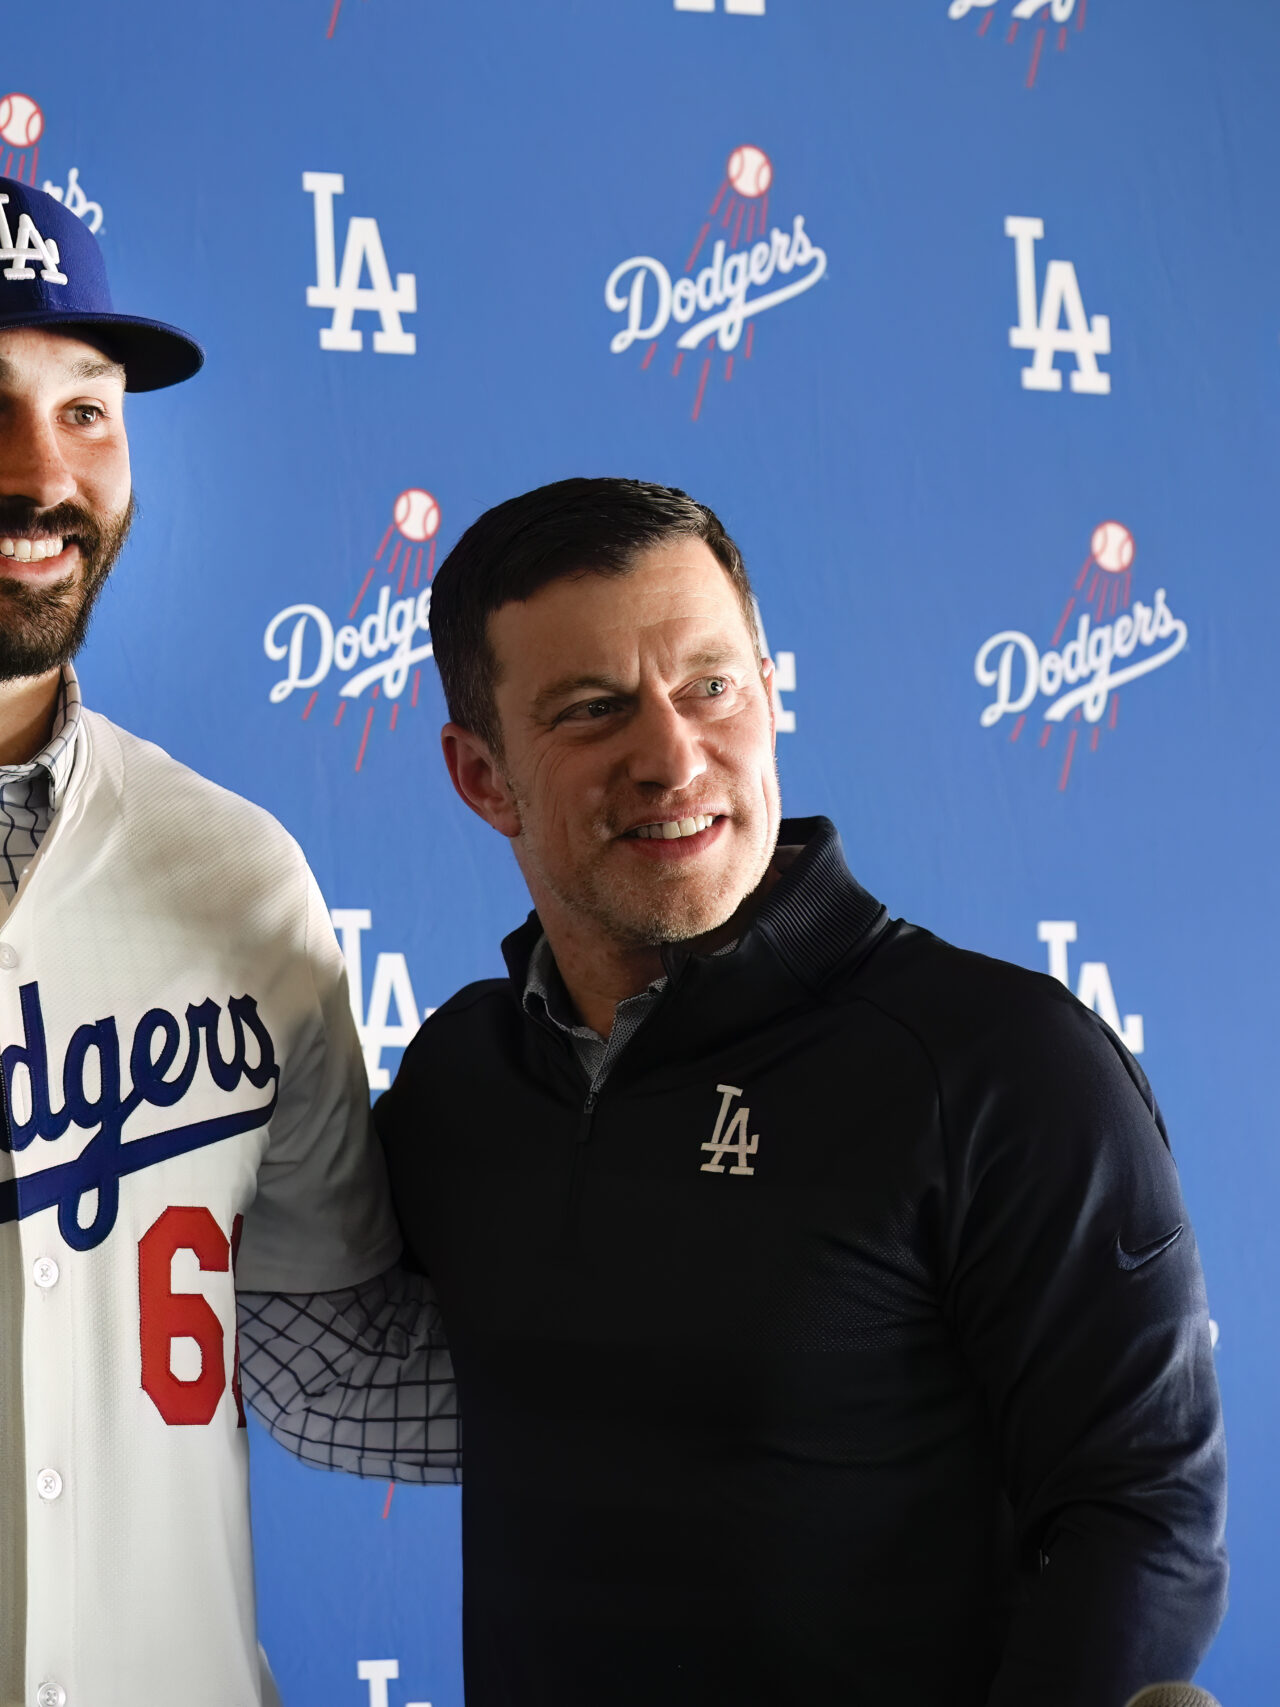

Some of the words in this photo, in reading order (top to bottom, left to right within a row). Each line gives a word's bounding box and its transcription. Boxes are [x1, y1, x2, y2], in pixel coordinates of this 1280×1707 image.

[302, 171, 417, 355] LA
[605, 215, 827, 354] Dodgers
[1005, 216, 1111, 394] LA
[263, 585, 433, 703] Dodge
[975, 588, 1188, 727] Dodgers
[700, 1084, 760, 1175] LA
[138, 1205, 247, 1428] 6
